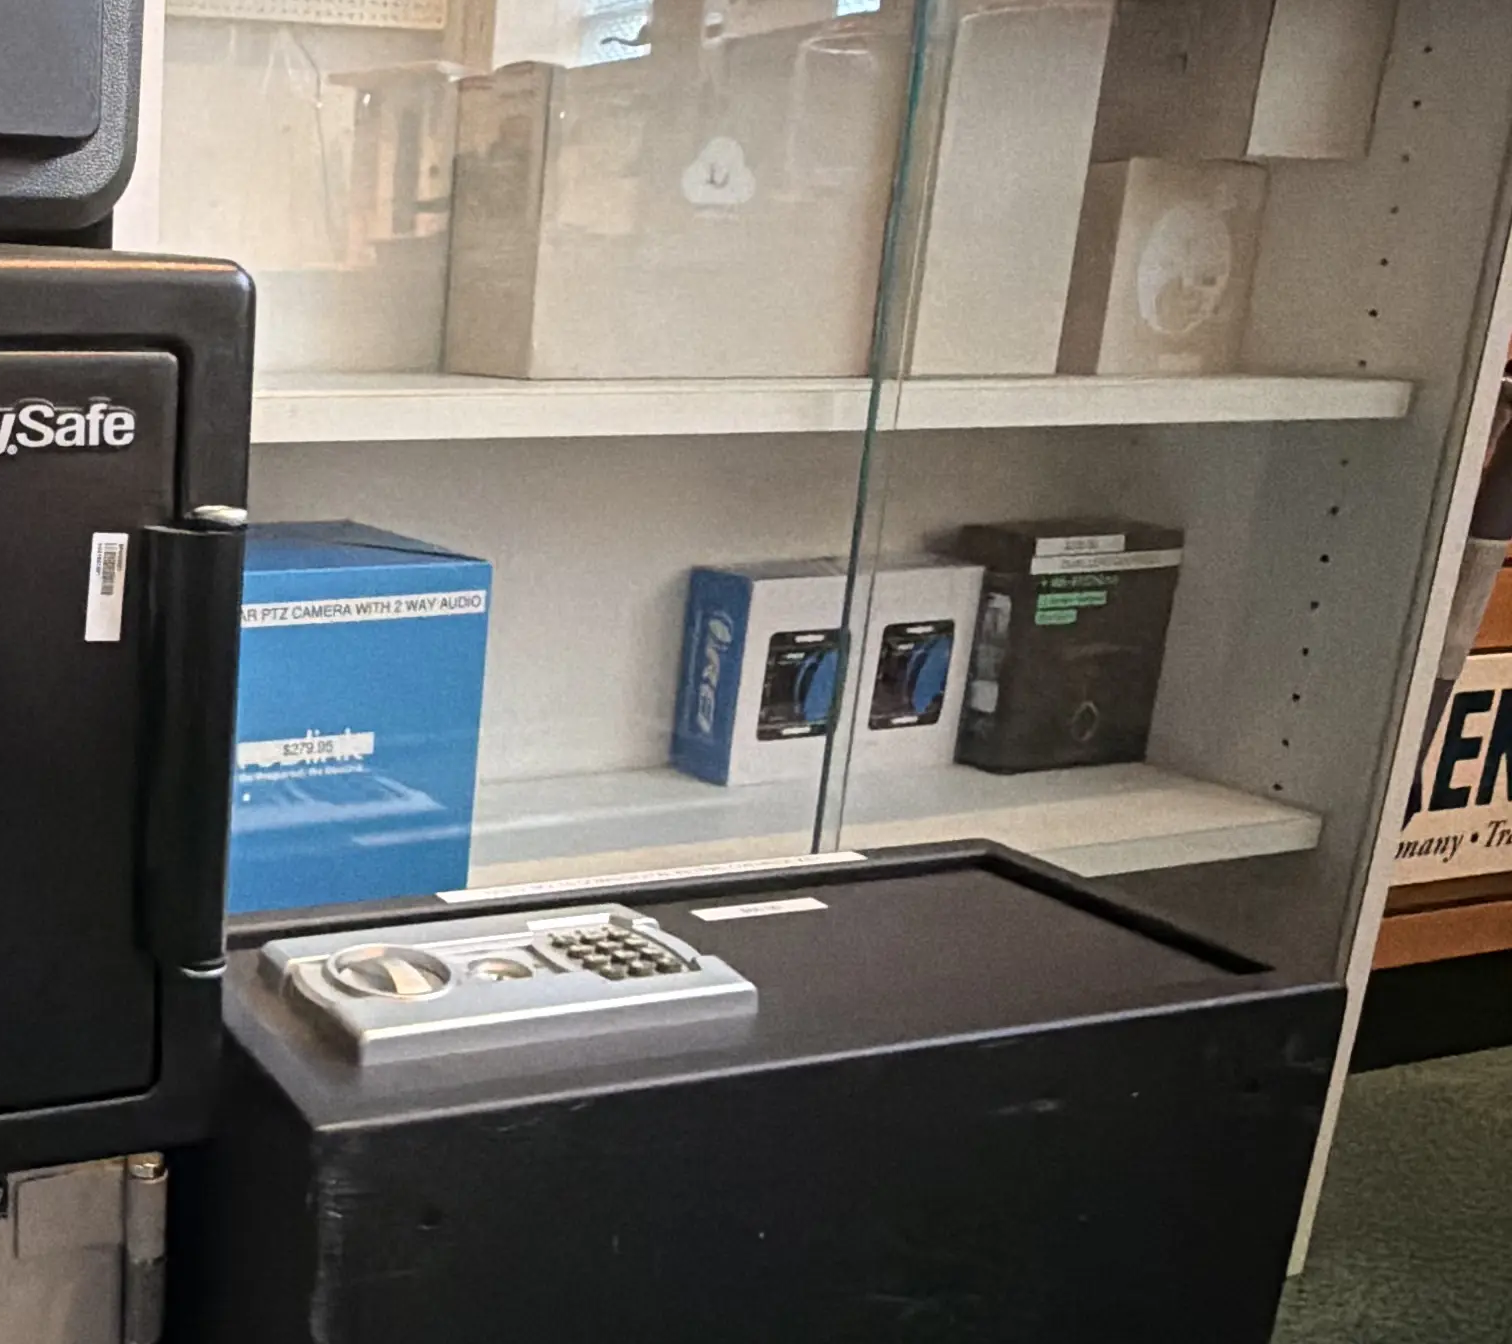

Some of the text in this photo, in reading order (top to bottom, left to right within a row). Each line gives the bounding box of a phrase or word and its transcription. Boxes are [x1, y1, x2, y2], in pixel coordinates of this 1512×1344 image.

[261, 606, 288, 622] PTZ
[291, 603, 351, 619] CAMERA
[356, 601, 390, 616] WITH
[394, 600, 403, 613] 2
[405, 597, 436, 612] WAY
[440, 595, 482, 610] AUDIO
